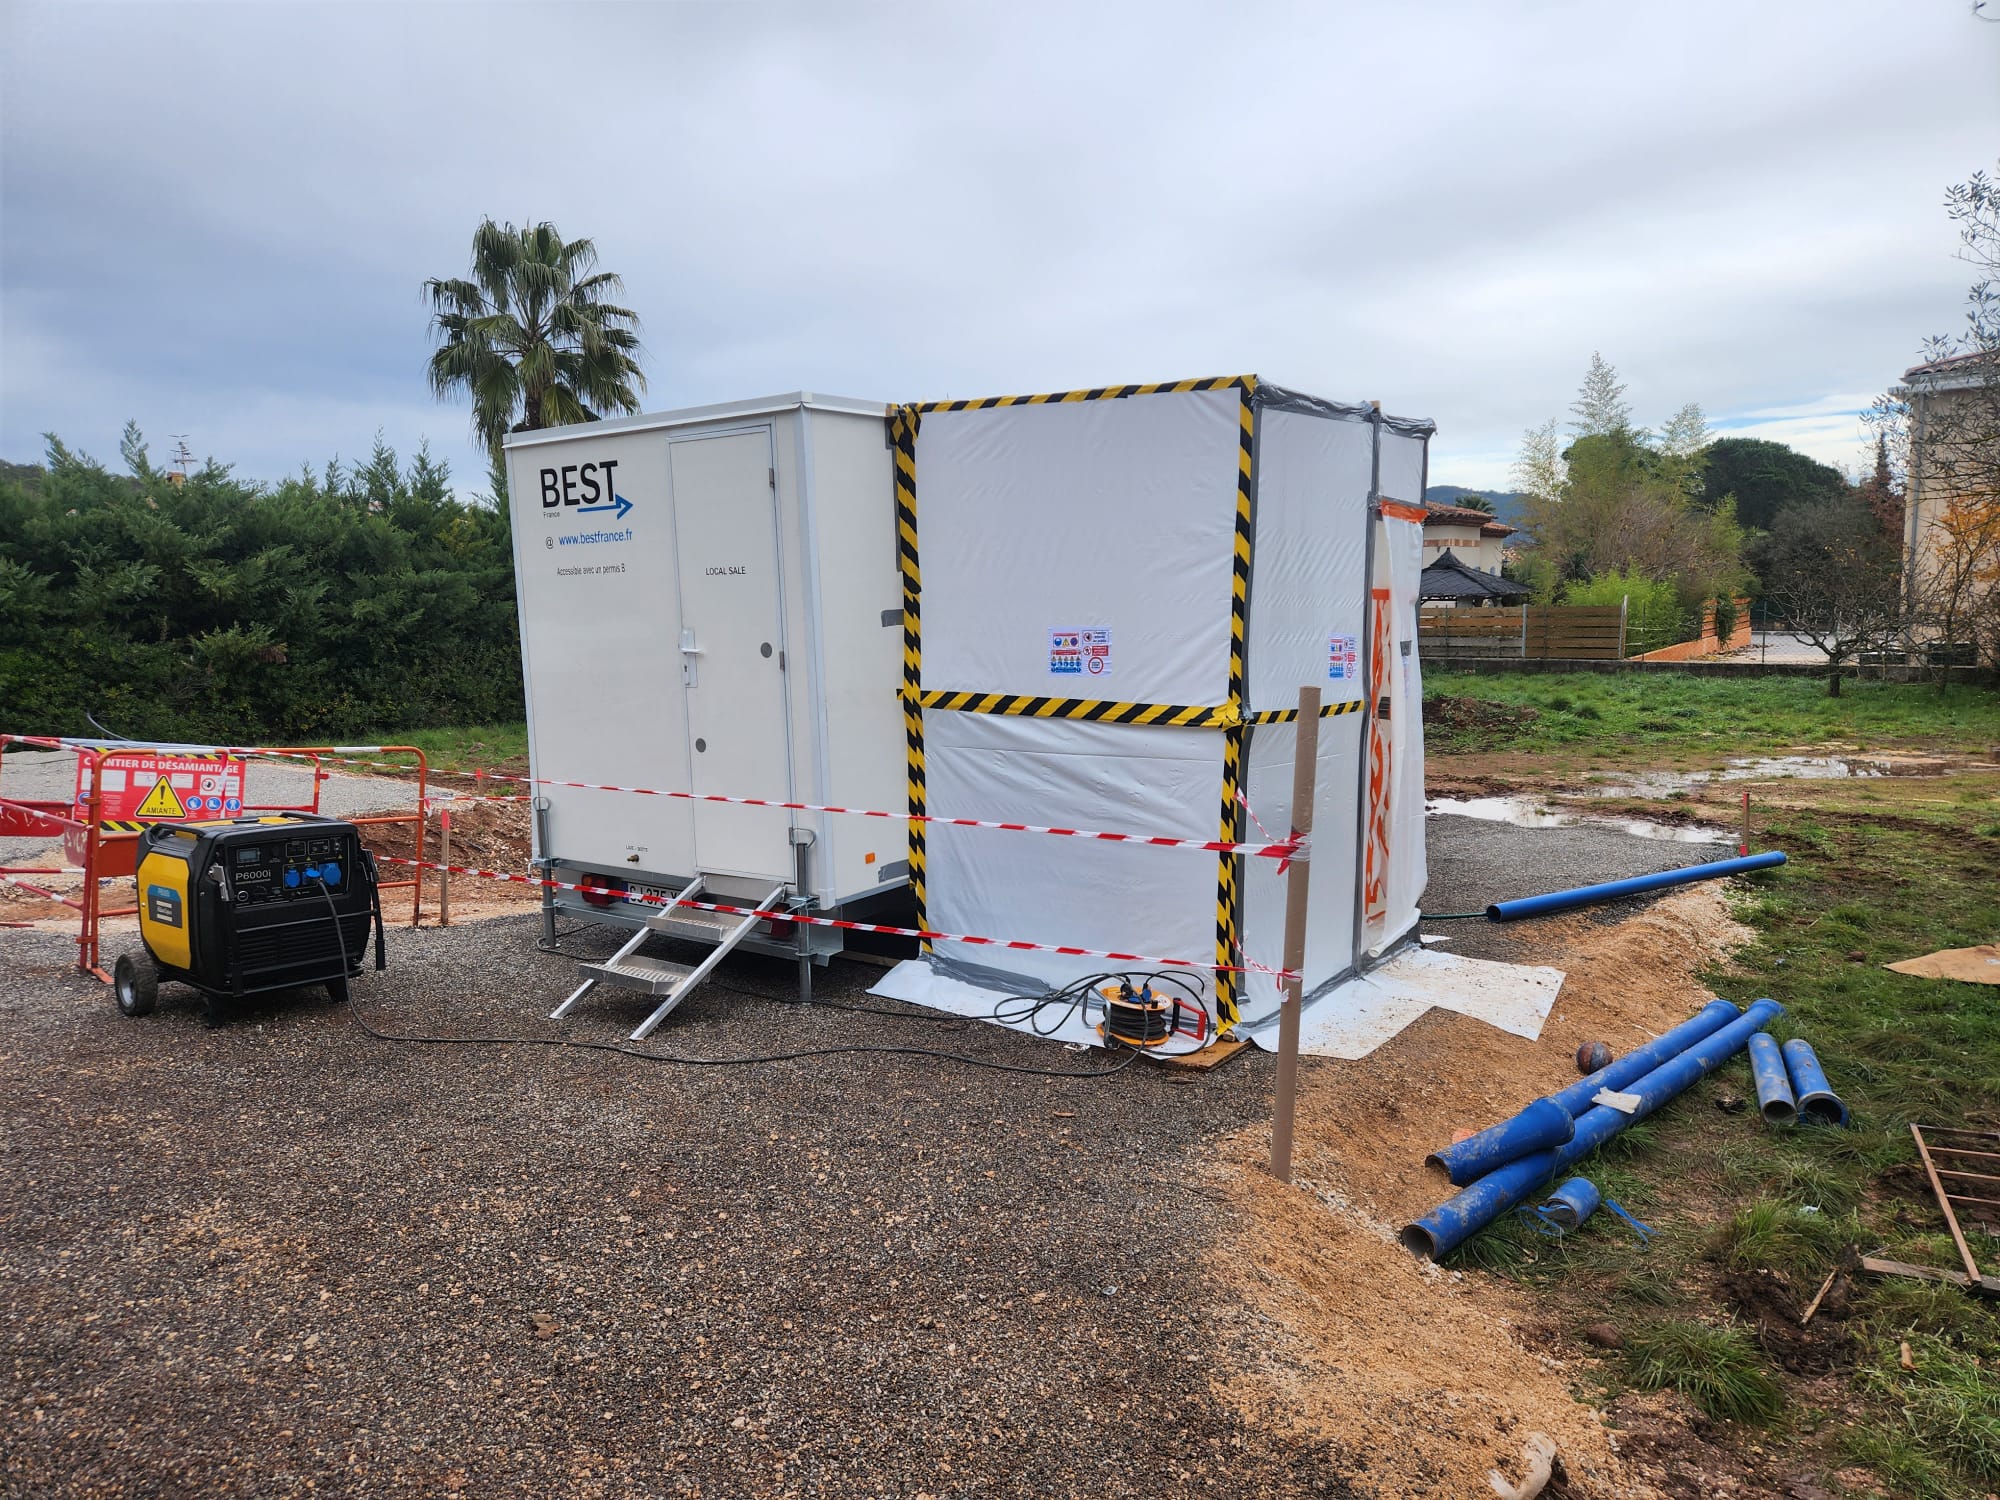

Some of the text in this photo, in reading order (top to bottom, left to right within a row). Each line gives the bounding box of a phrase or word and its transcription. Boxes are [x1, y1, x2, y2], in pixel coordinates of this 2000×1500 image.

[540, 460, 618, 508] BEST
[544, 511, 560, 519] France
[546, 528, 632, 549] @ www.bestfrance.fr
[557, 565, 582, 576] Accessible
[583, 566, 594, 575] avec
[596, 565, 601, 574] un
[603, 564, 620, 575] permis
[705, 566, 746, 576] LOCAL SALE
[84, 757, 239, 773] CANTIER DE DÉSAMIANTGE
[146, 807, 177, 815] AMIANTE
[235, 869, 272, 881] P6000i
